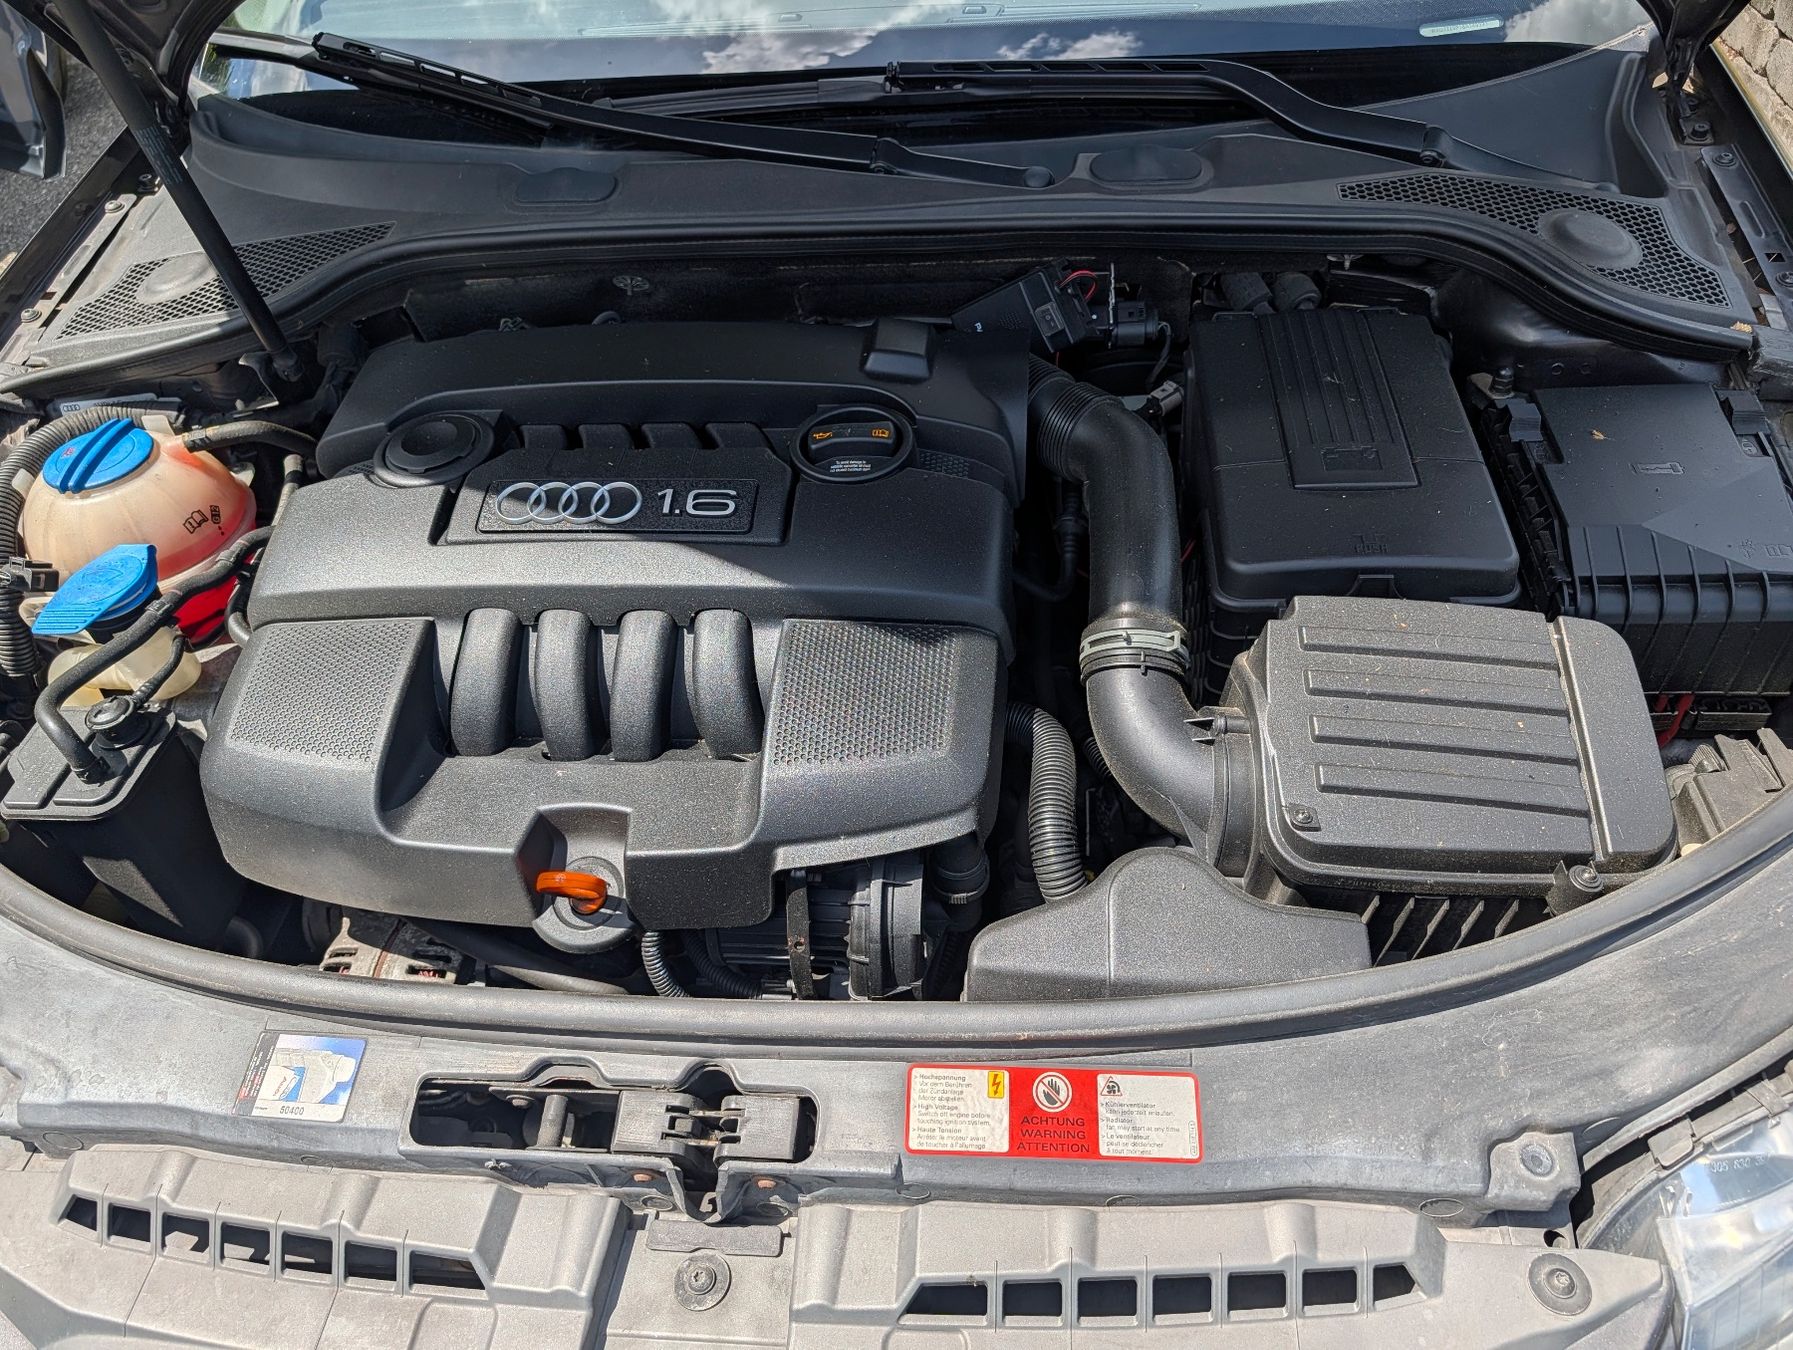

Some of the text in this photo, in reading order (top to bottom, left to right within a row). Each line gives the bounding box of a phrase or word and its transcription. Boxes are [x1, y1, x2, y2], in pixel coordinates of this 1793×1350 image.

[657, 488, 737, 516] 1.6
[279, 1105, 305, 1116] 50400
[1020, 1116, 1085, 1127] ACHTUNG
[1020, 1129, 1086, 1140] WARNING
[1016, 1141, 1090, 1153] ATTENTION
